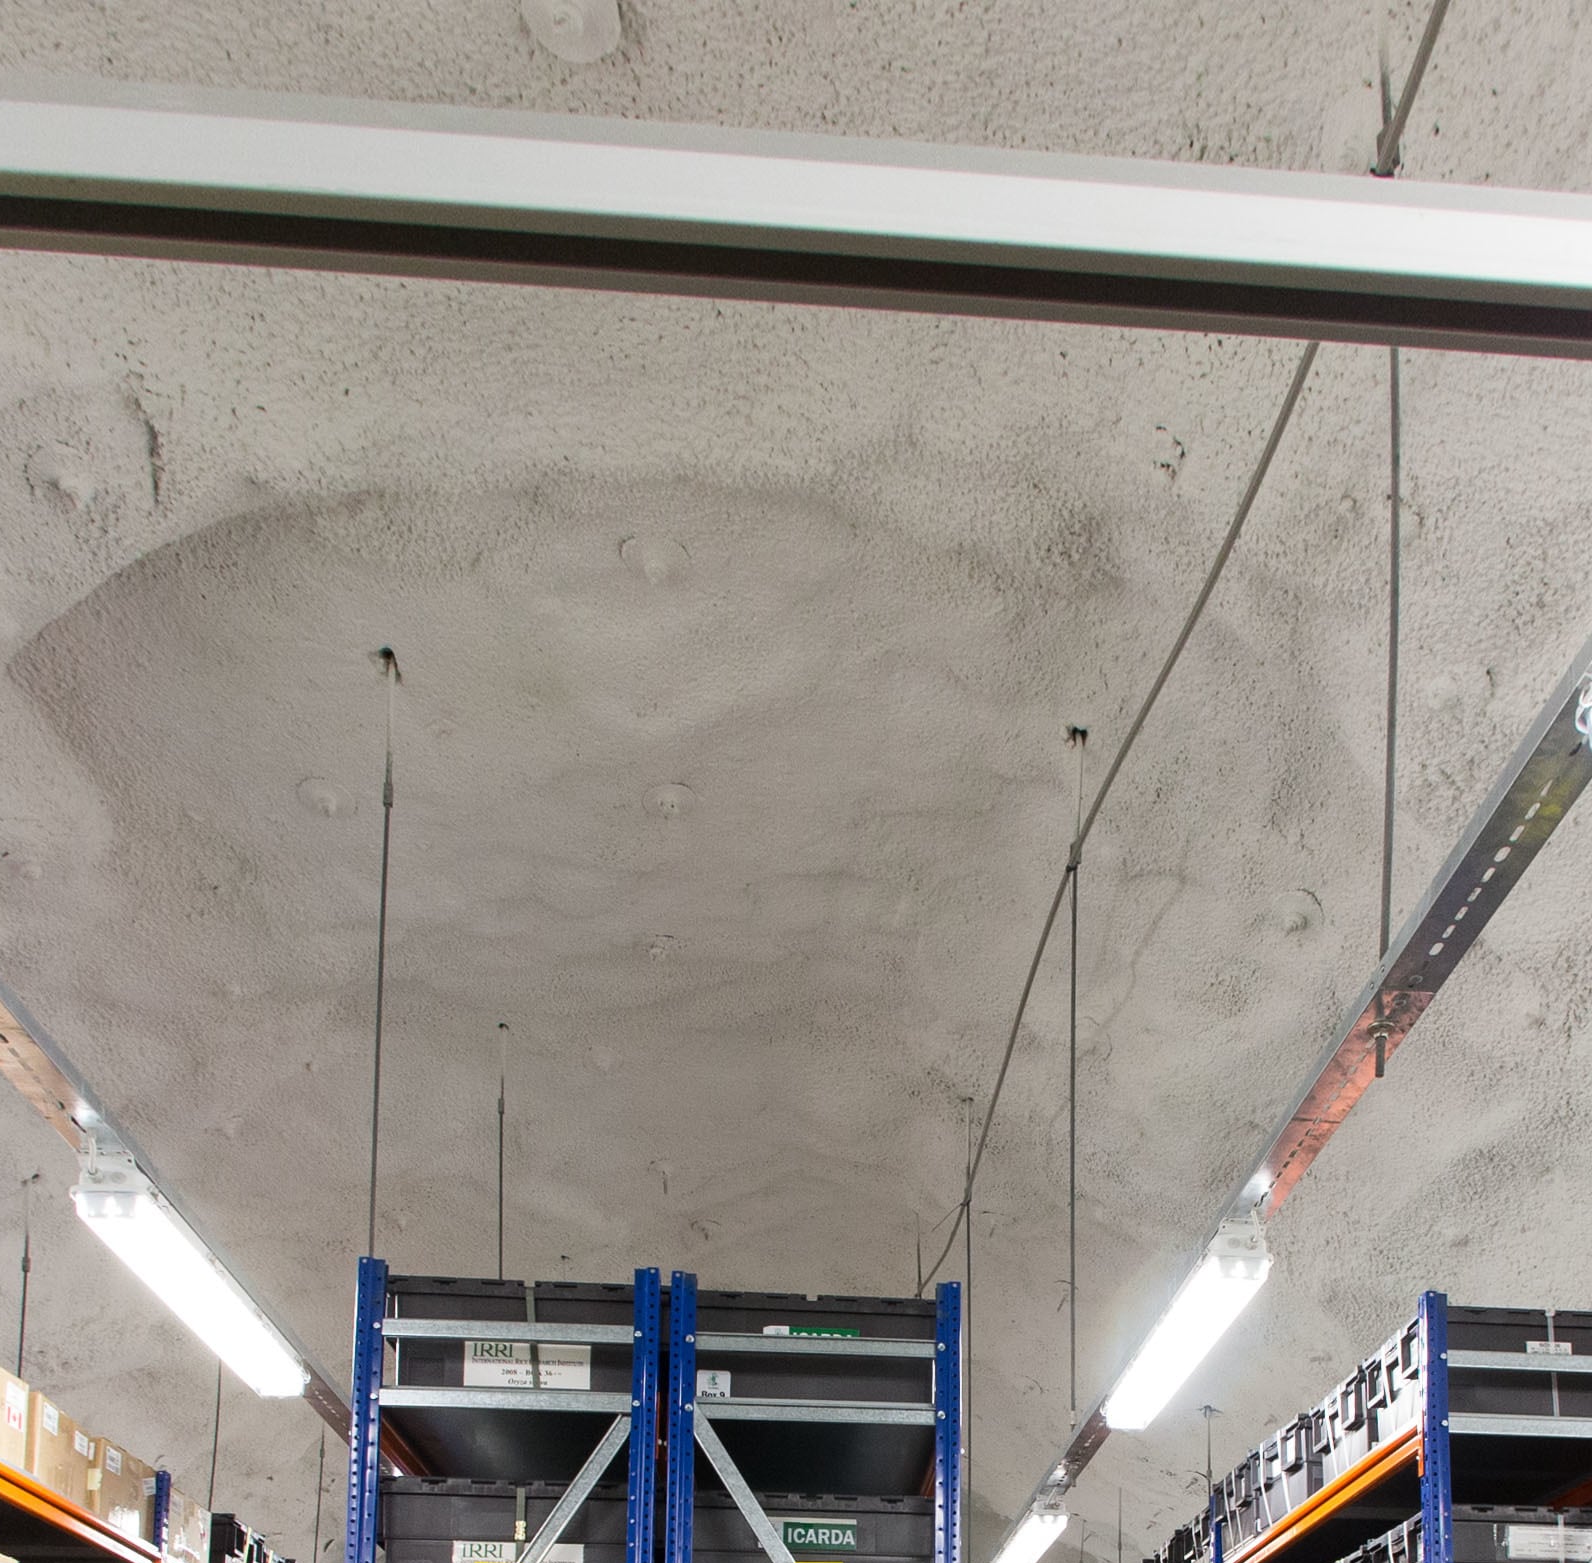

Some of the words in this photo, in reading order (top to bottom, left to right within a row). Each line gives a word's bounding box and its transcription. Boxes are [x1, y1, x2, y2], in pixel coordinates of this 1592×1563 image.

[473, 1342, 513, 1357] IRRI
[788, 1527, 855, 1545] ICARDA
[463, 1543, 503, 1558] IRRI
